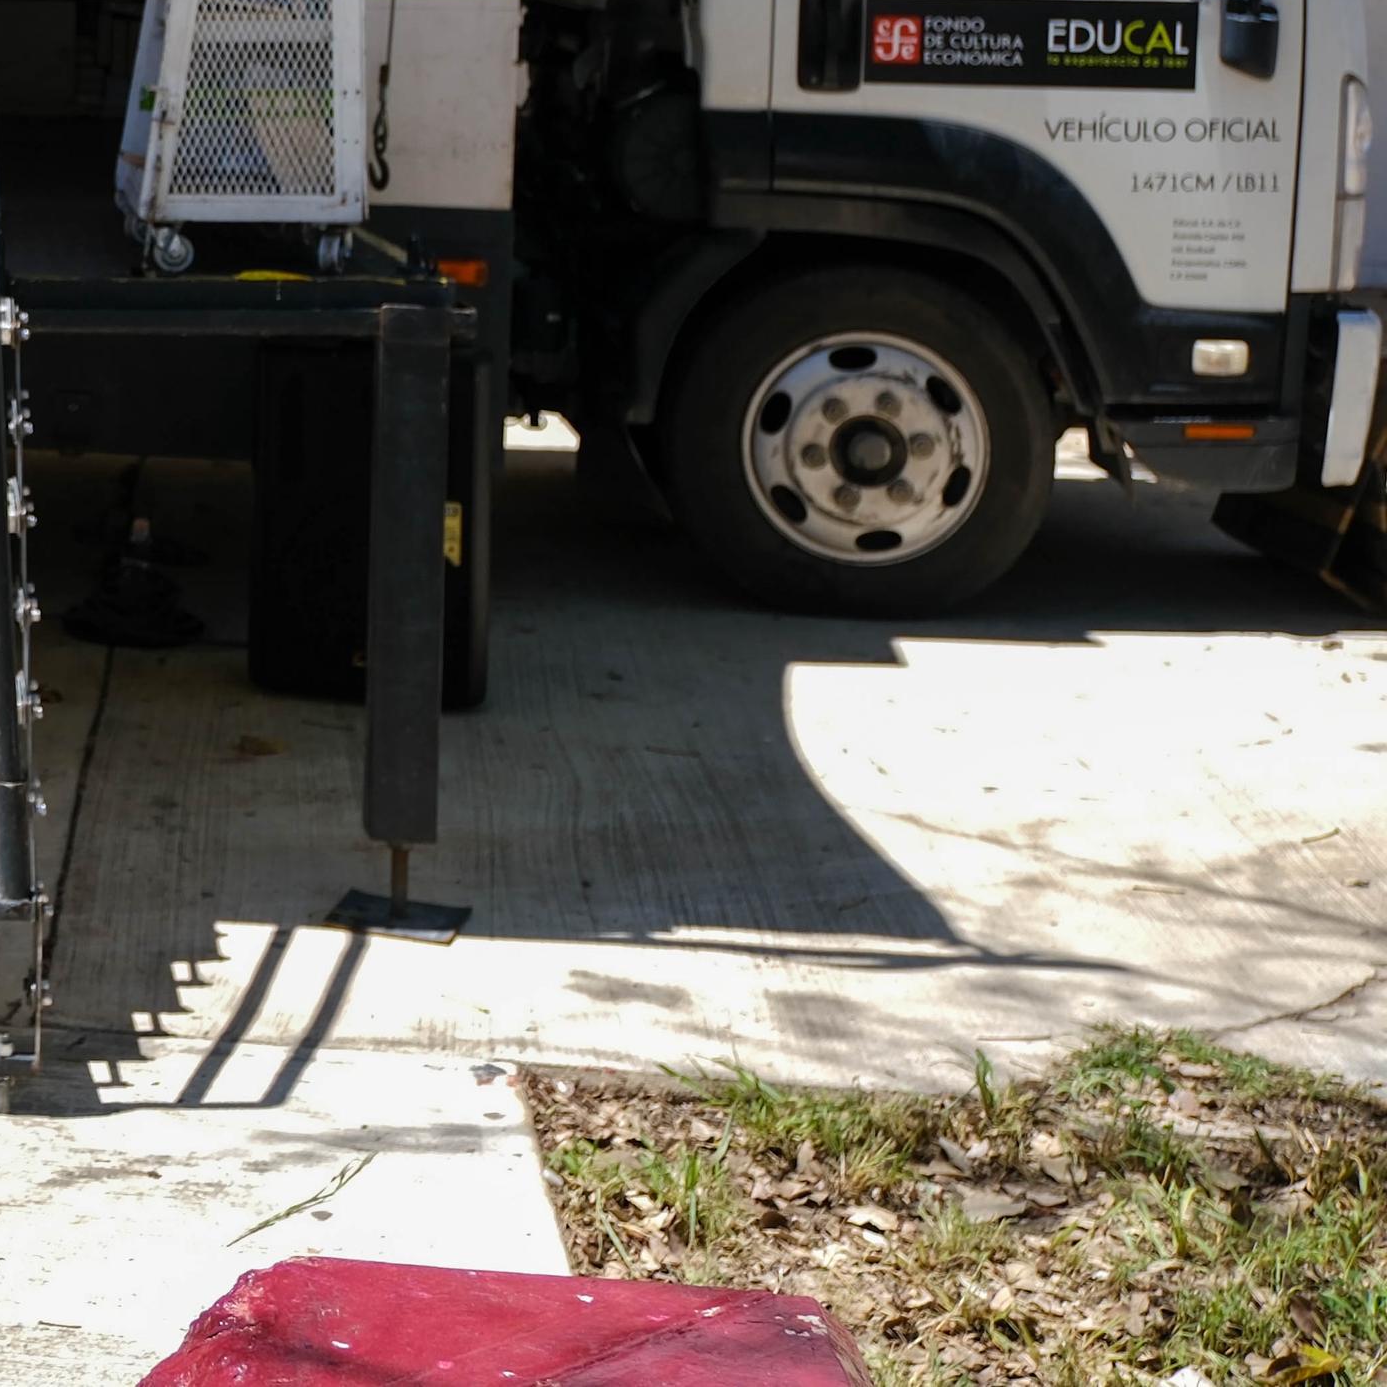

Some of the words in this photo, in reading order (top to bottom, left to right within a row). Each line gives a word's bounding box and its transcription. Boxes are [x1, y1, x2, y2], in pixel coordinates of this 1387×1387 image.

[924, 16, 986, 33] FONDO
[1047, 18, 1190, 55] EDUCAL
[924, 34, 944, 49] DE
[949, 34, 1025, 51] CULTURA
[1044, 111, 1177, 143] VEHÍCULO
[1184, 117, 1282, 143] OFICIAL
[1131, 170, 1215, 194] 1471CM
